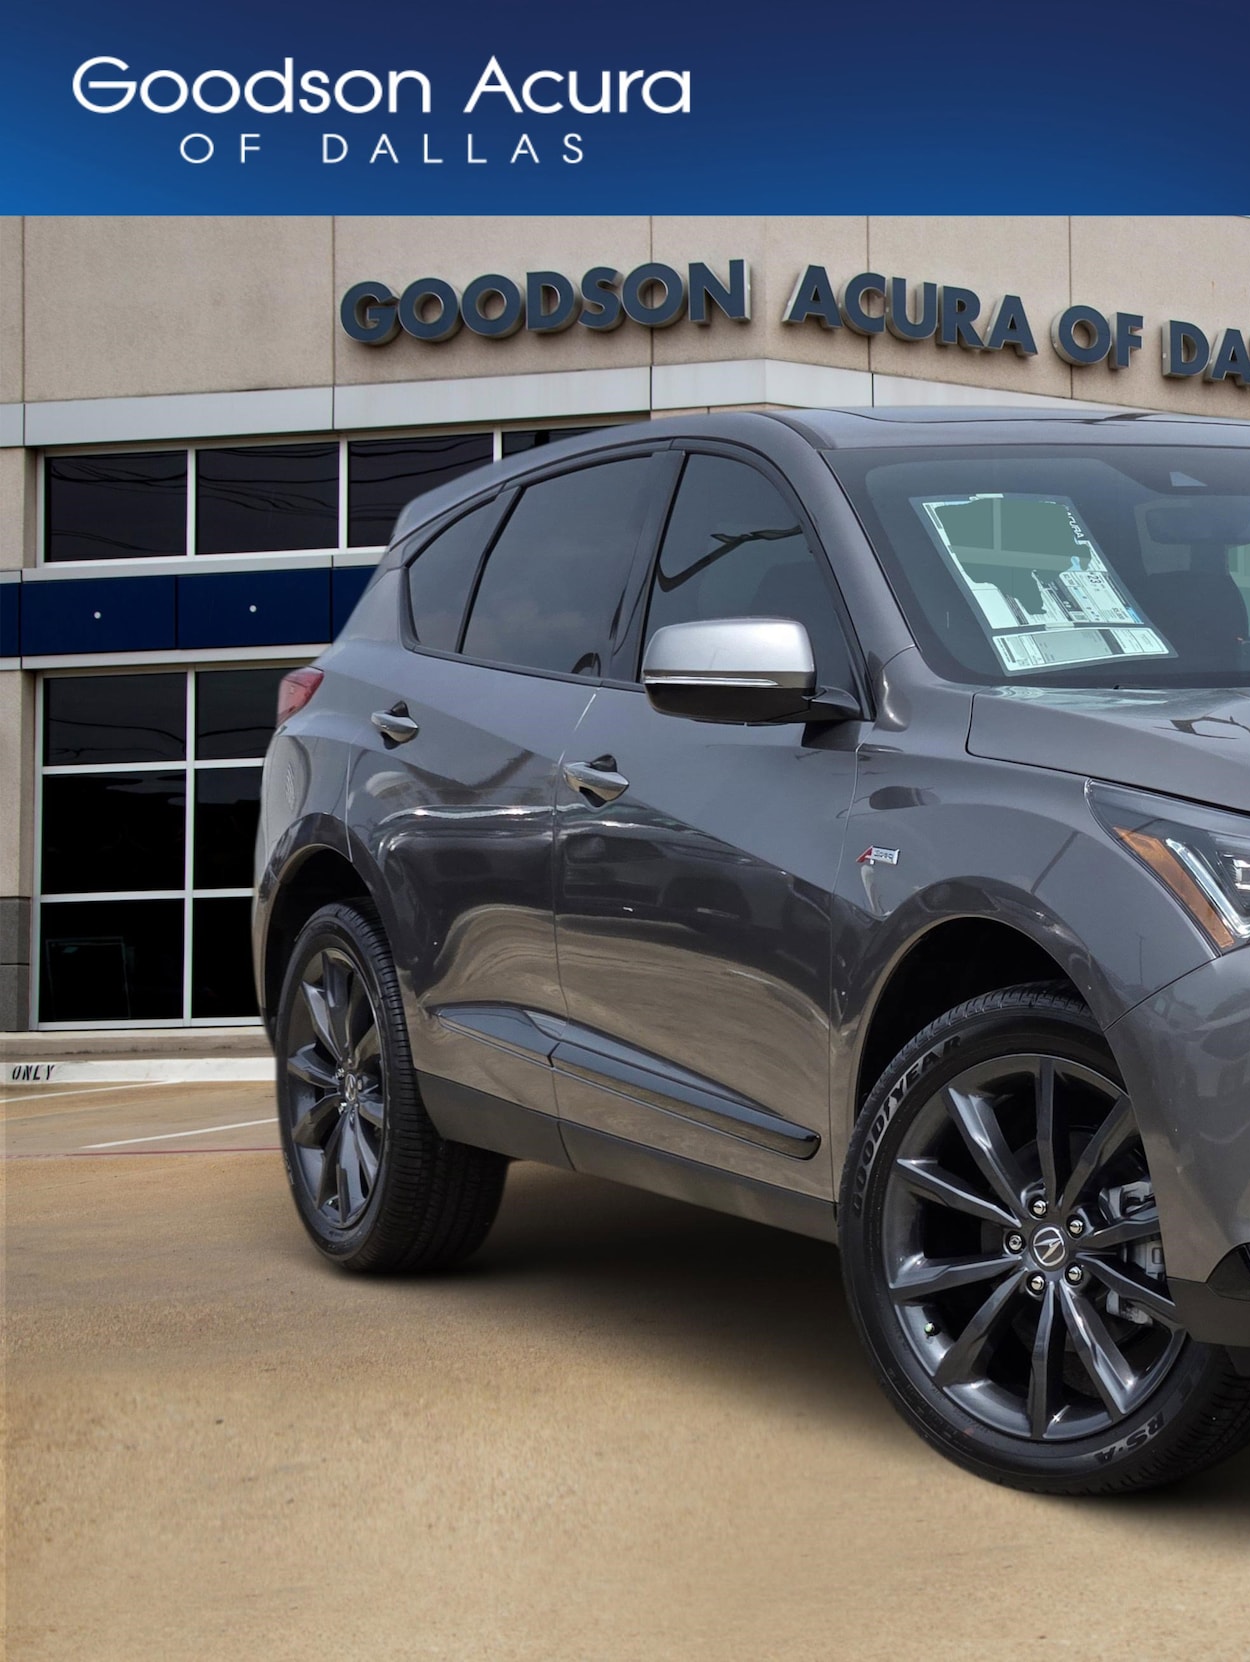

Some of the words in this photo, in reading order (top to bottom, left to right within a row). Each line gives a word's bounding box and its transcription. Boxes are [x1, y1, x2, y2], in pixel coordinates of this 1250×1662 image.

[340, 258, 751, 345] GOODSON
[782, 264, 1038, 356] ACURA
[1050, 304, 1144, 370] OF
[11, 1064, 56, 1081] ONLY
